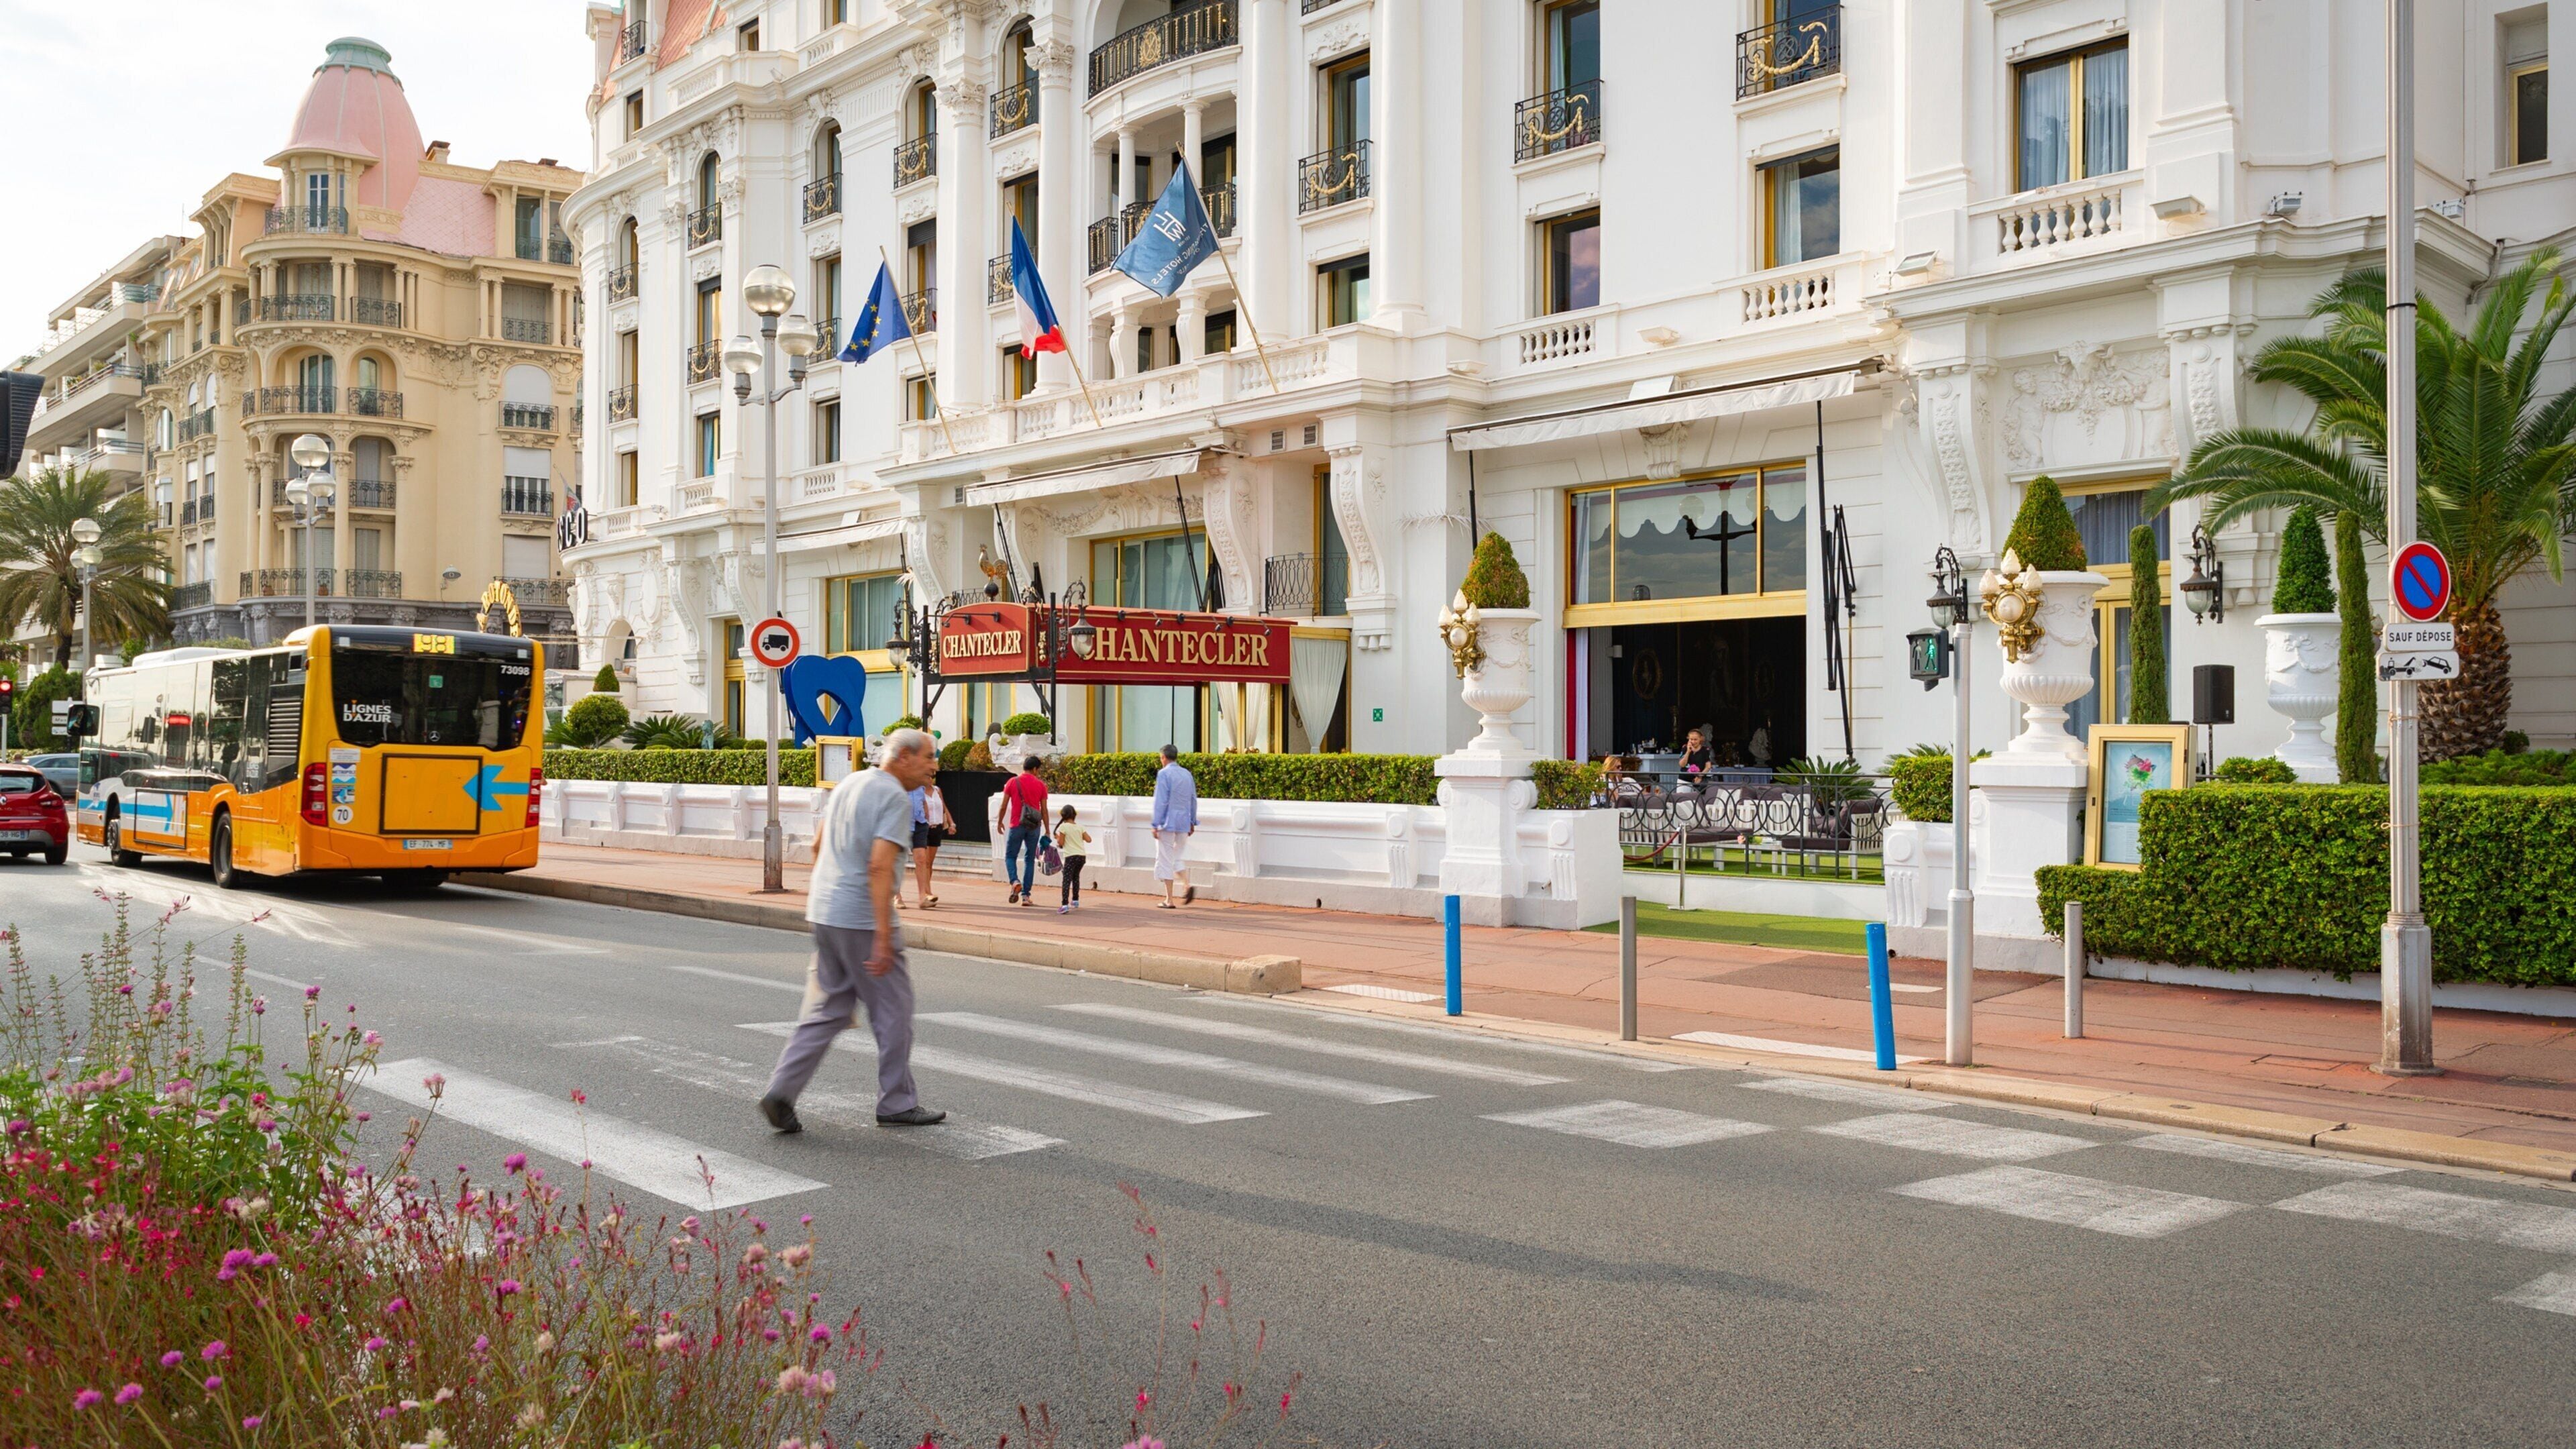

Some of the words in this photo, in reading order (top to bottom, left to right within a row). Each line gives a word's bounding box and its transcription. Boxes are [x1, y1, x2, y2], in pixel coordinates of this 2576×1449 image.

[2389, 632, 2412, 642] SAUF
[2416, 629, 2451, 641] DÉPOSE
[943, 630, 1022, 659] CHANTECLER
[500, 665, 530, 676] 73098
[343, 703, 392, 714] LIGNES
[337, 809, 349, 821] 70
